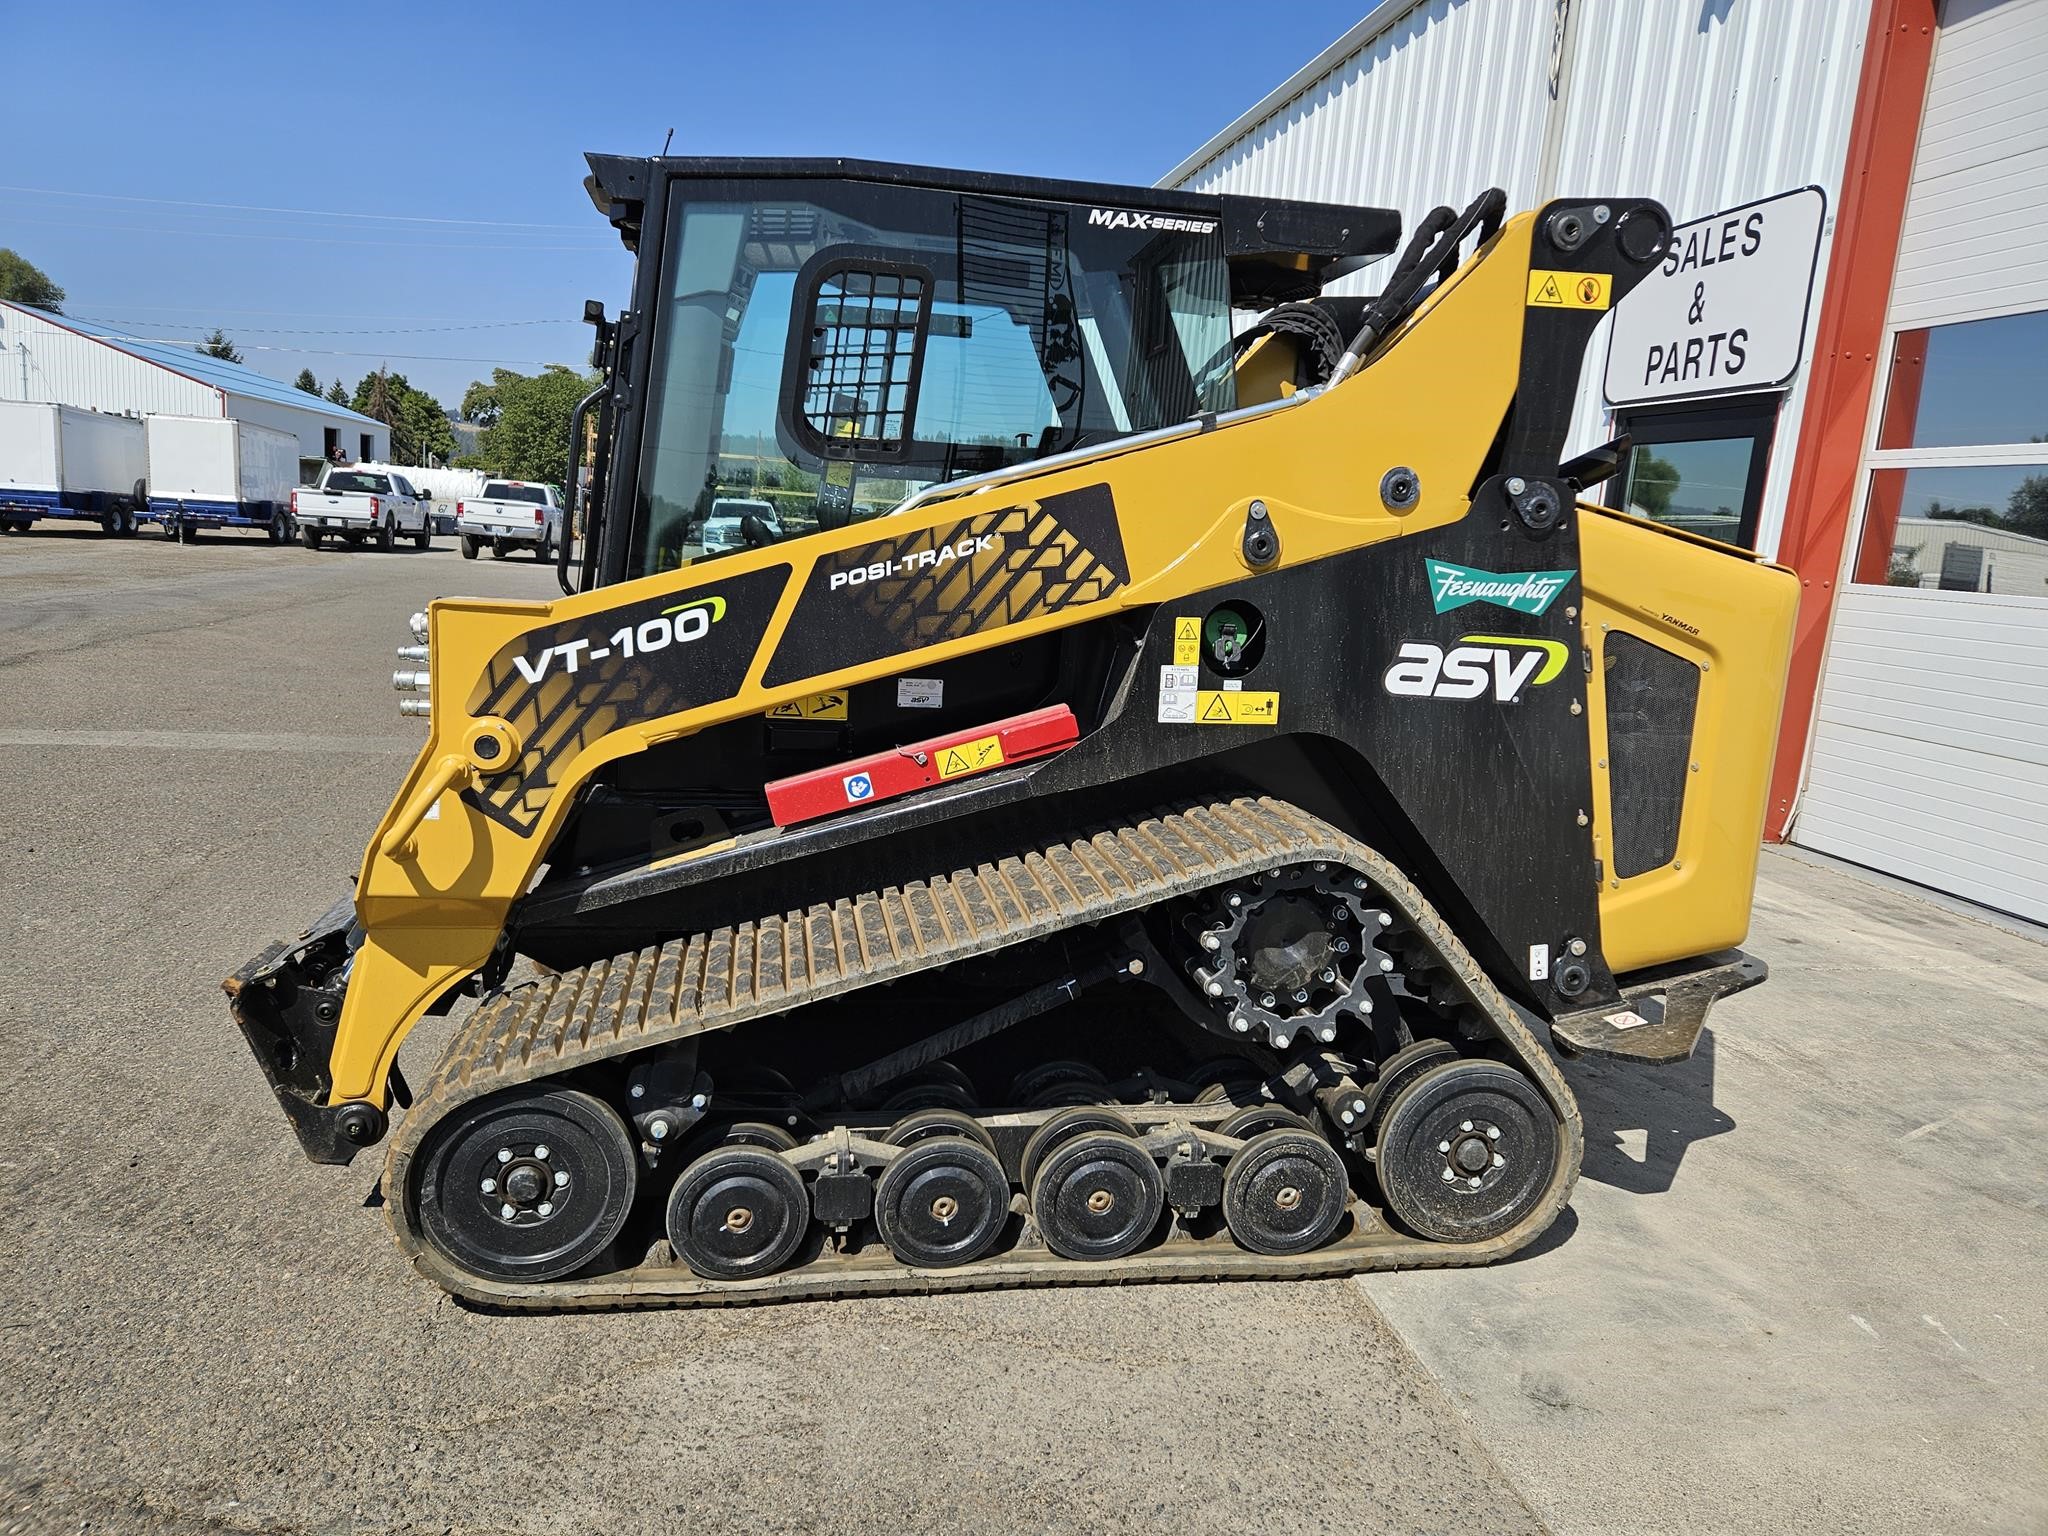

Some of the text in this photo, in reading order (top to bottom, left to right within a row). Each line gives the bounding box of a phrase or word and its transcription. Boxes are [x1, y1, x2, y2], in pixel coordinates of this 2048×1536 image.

[1088, 209, 1213, 233] MAX-SERIES
[1664, 212, 1763, 277] SALES
[1688, 281, 1705, 325] &
[1644, 328, 1748, 386] PARTS
[830, 534, 994, 591] POSI-TRACK
[1434, 566, 1564, 613] Feenaughty
[512, 608, 709, 684] VT-100
[1661, 613, 1700, 635] YANMAR
[1385, 640, 1550, 701] asv
